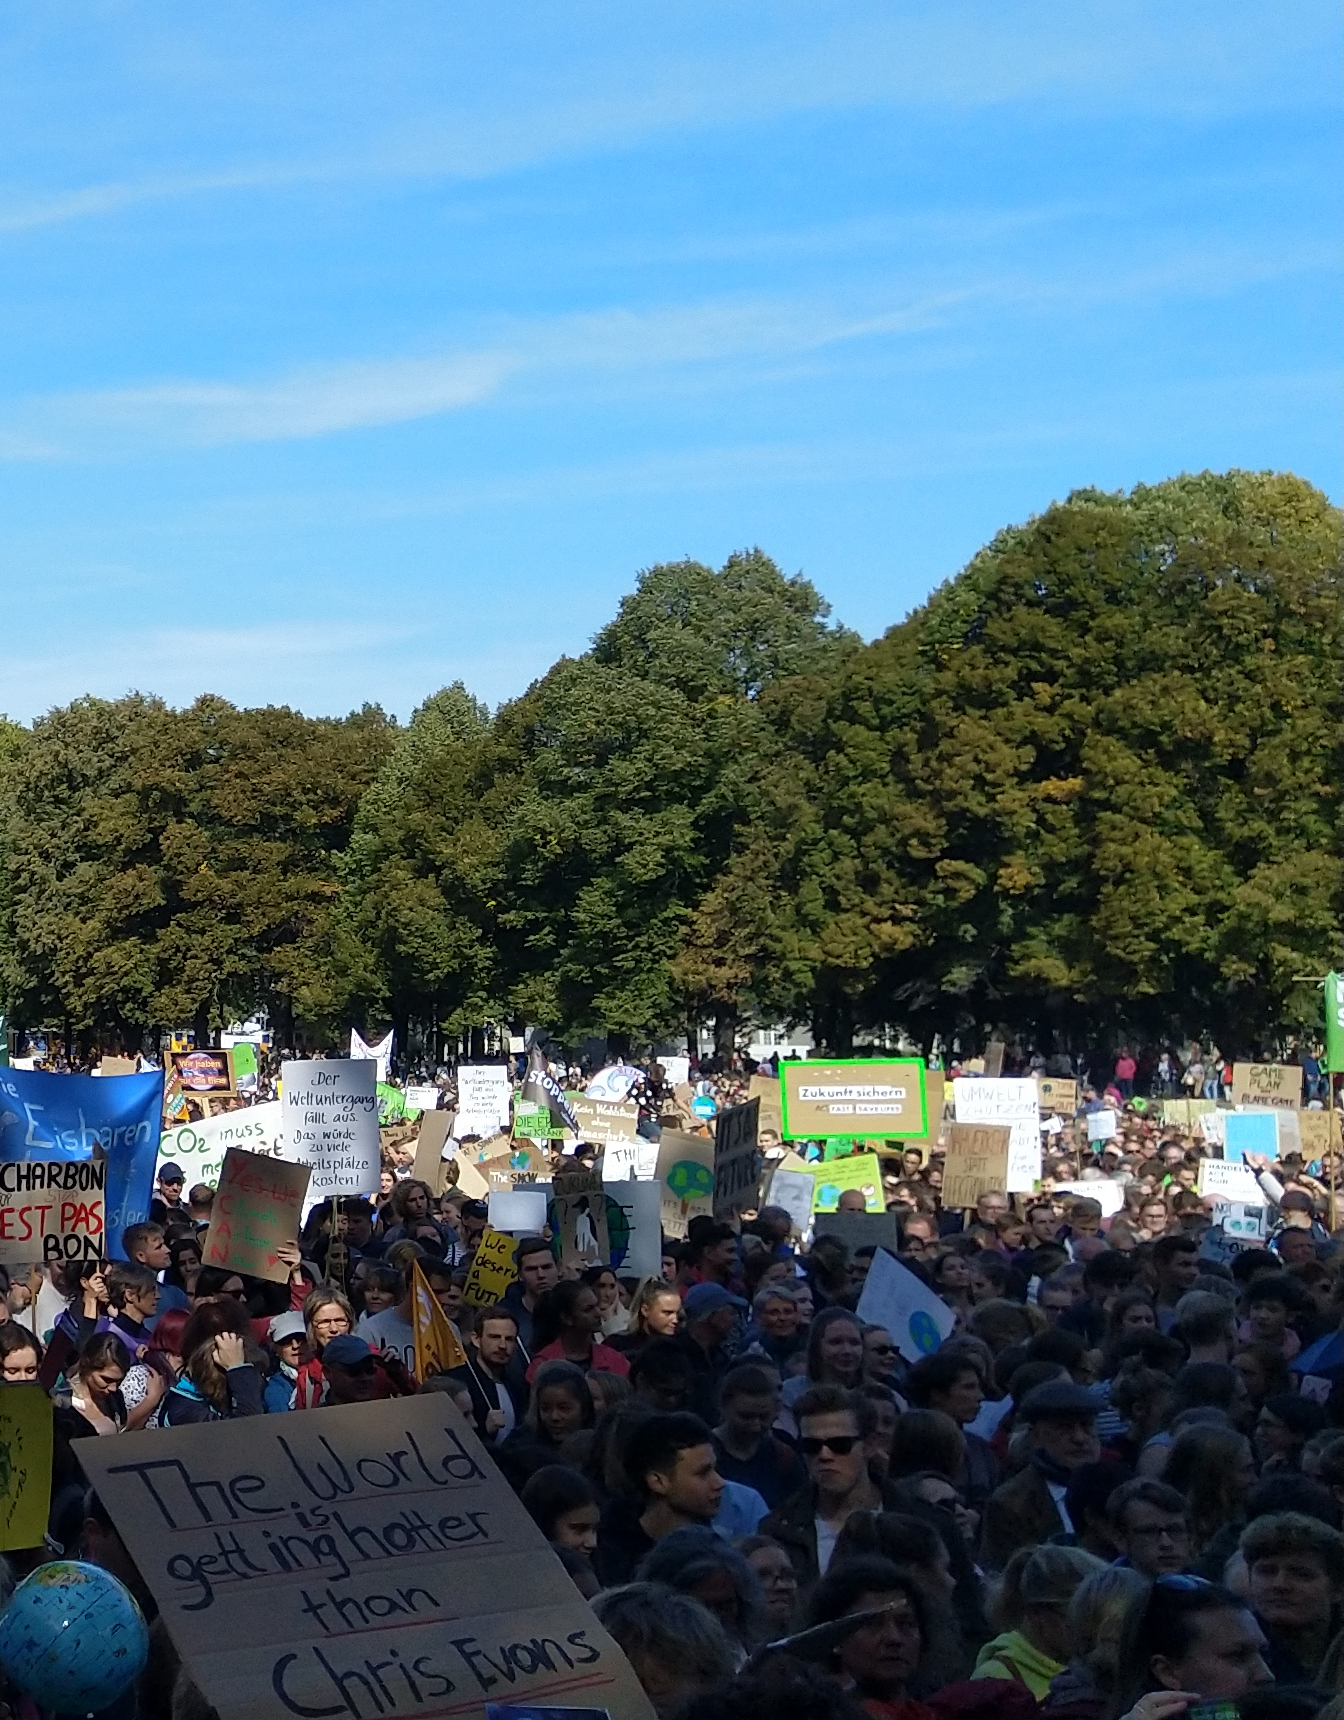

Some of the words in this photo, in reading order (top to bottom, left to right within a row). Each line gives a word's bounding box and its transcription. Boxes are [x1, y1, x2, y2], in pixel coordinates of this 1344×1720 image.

[311, 1071, 340, 1086] Der
[1249, 1066, 1285, 1079] GAME
[801, 1087, 854, 1098] Zukunft
[856, 1086, 903, 1098] sichern
[1249, 1078, 1282, 1090] PLAN
[288, 1091, 375, 1112] Weltuntergang
[961, 1085, 1025, 1102] UMWELT
[304, 1111, 328, 1126] fällt
[332, 1112, 359, 1123] aus.
[573, 1102, 594, 1115] Kein
[595, 1103, 638, 1119] Wohlstand
[516, 1116, 533, 1128] DIE
[591, 1117, 611, 1128] ohne
[220, 1122, 264, 1141] muss
[293, 1129, 317, 1144] Das
[322, 1128, 357, 1141] würde
[533, 1128, 564, 1137] KRANK
[309, 1144, 324, 1153] zu
[326, 1142, 351, 1153] viele
[0, 1162, 104, 1192] CHARBON
[1208, 1164, 1242, 1173] HANDEL
[312, 1174, 360, 1187] kosten!
[490, 1172, 509, 1183] The
[60, 1200, 103, 1236] PAS
[42, 1231, 104, 1262] BON
[484, 1233, 506, 1255] We
[472, 1268, 480, 1280] a
[475, 1255, 518, 1279] deserv
[464, 1283, 499, 1304] FUT
[107, 1459, 289, 1531] The
[276, 1427, 489, 1503] World
[291, 1501, 331, 1531] is
[346, 1509, 491, 1563] hotter
[300, 1584, 442, 1633] than
[271, 1646, 457, 1720] Chris
[452, 1629, 602, 1695] Evans
